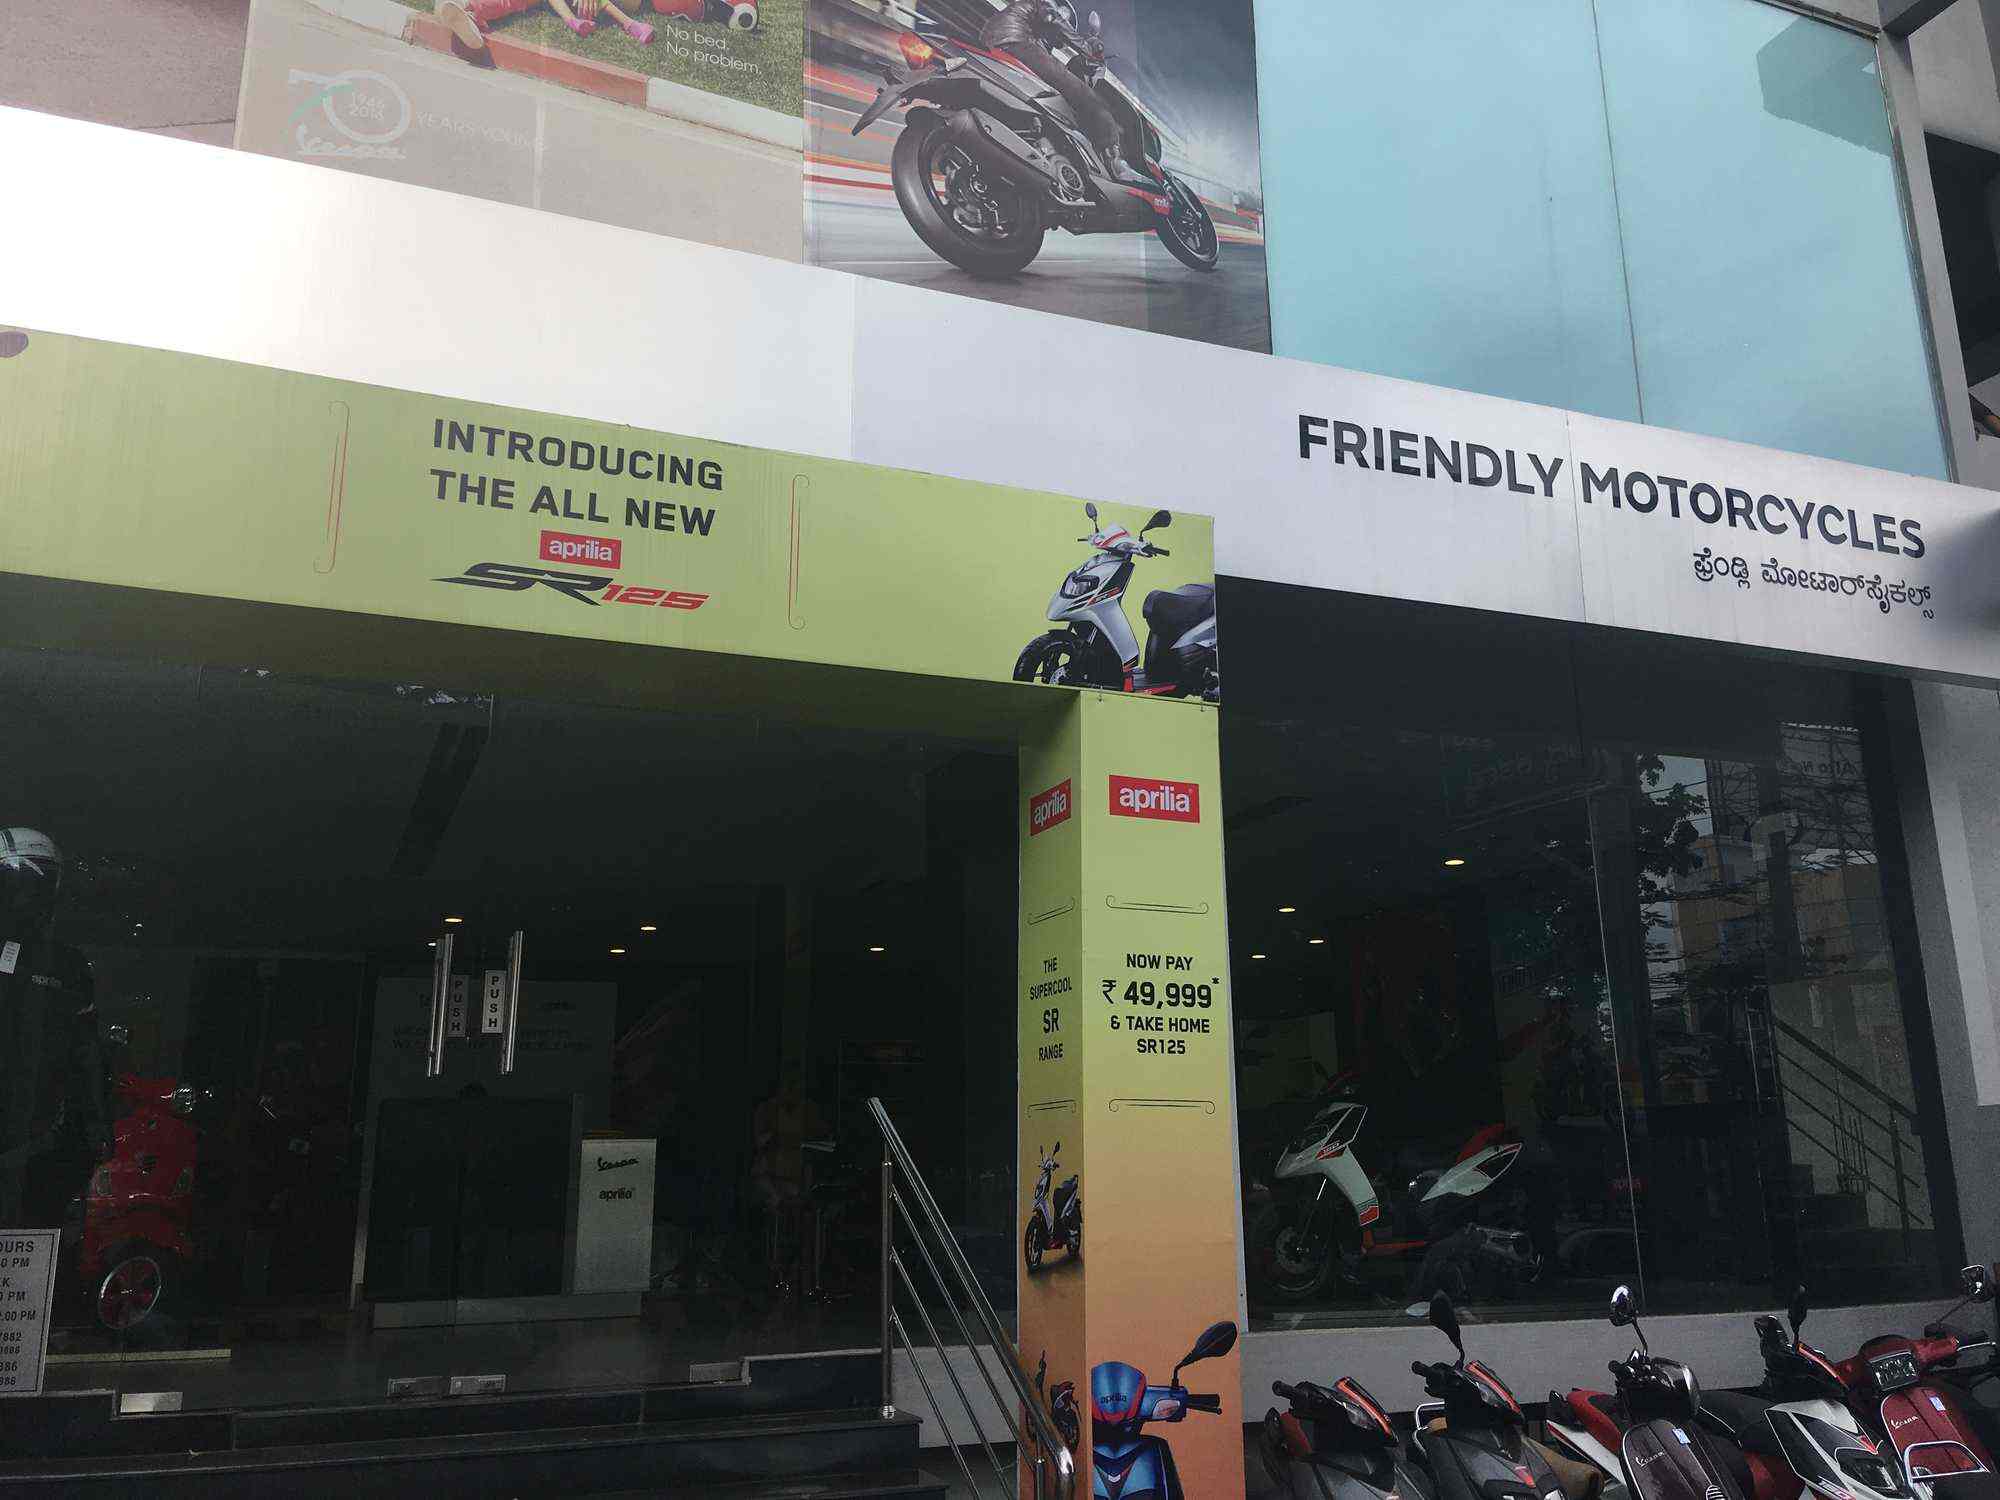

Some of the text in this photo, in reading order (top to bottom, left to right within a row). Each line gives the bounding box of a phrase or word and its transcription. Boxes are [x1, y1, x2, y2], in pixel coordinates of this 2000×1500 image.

[665, 24, 689, 41] No
[665, 41, 689, 57] No
[433, 418, 724, 491] INTRODUCING
[1298, 414, 1926, 559] FRIENDLY MOTORCYCLES
[430, 468, 716, 536] THE ALL NEW
[549, 538, 613, 562] aprilia
[1033, 790, 1067, 827] aprilia
[1119, 785, 1191, 813] aprilia
[1043, 957, 1057, 974] THE
[1126, 953, 1193, 971] NOW PAY
[1029, 977, 1072, 1000] SUPERCOOL
[451, 980, 464, 1032] PUSH
[487, 976, 501, 1028] PUSH
[1043, 1008, 1059, 1034] SR
[1110, 1015, 1210, 1034] & TAKE HOME
[1038, 1042, 1064, 1062] RANGE
[1136, 1038, 1186, 1055] SR125
[599, 1187, 633, 1201] aprilia
